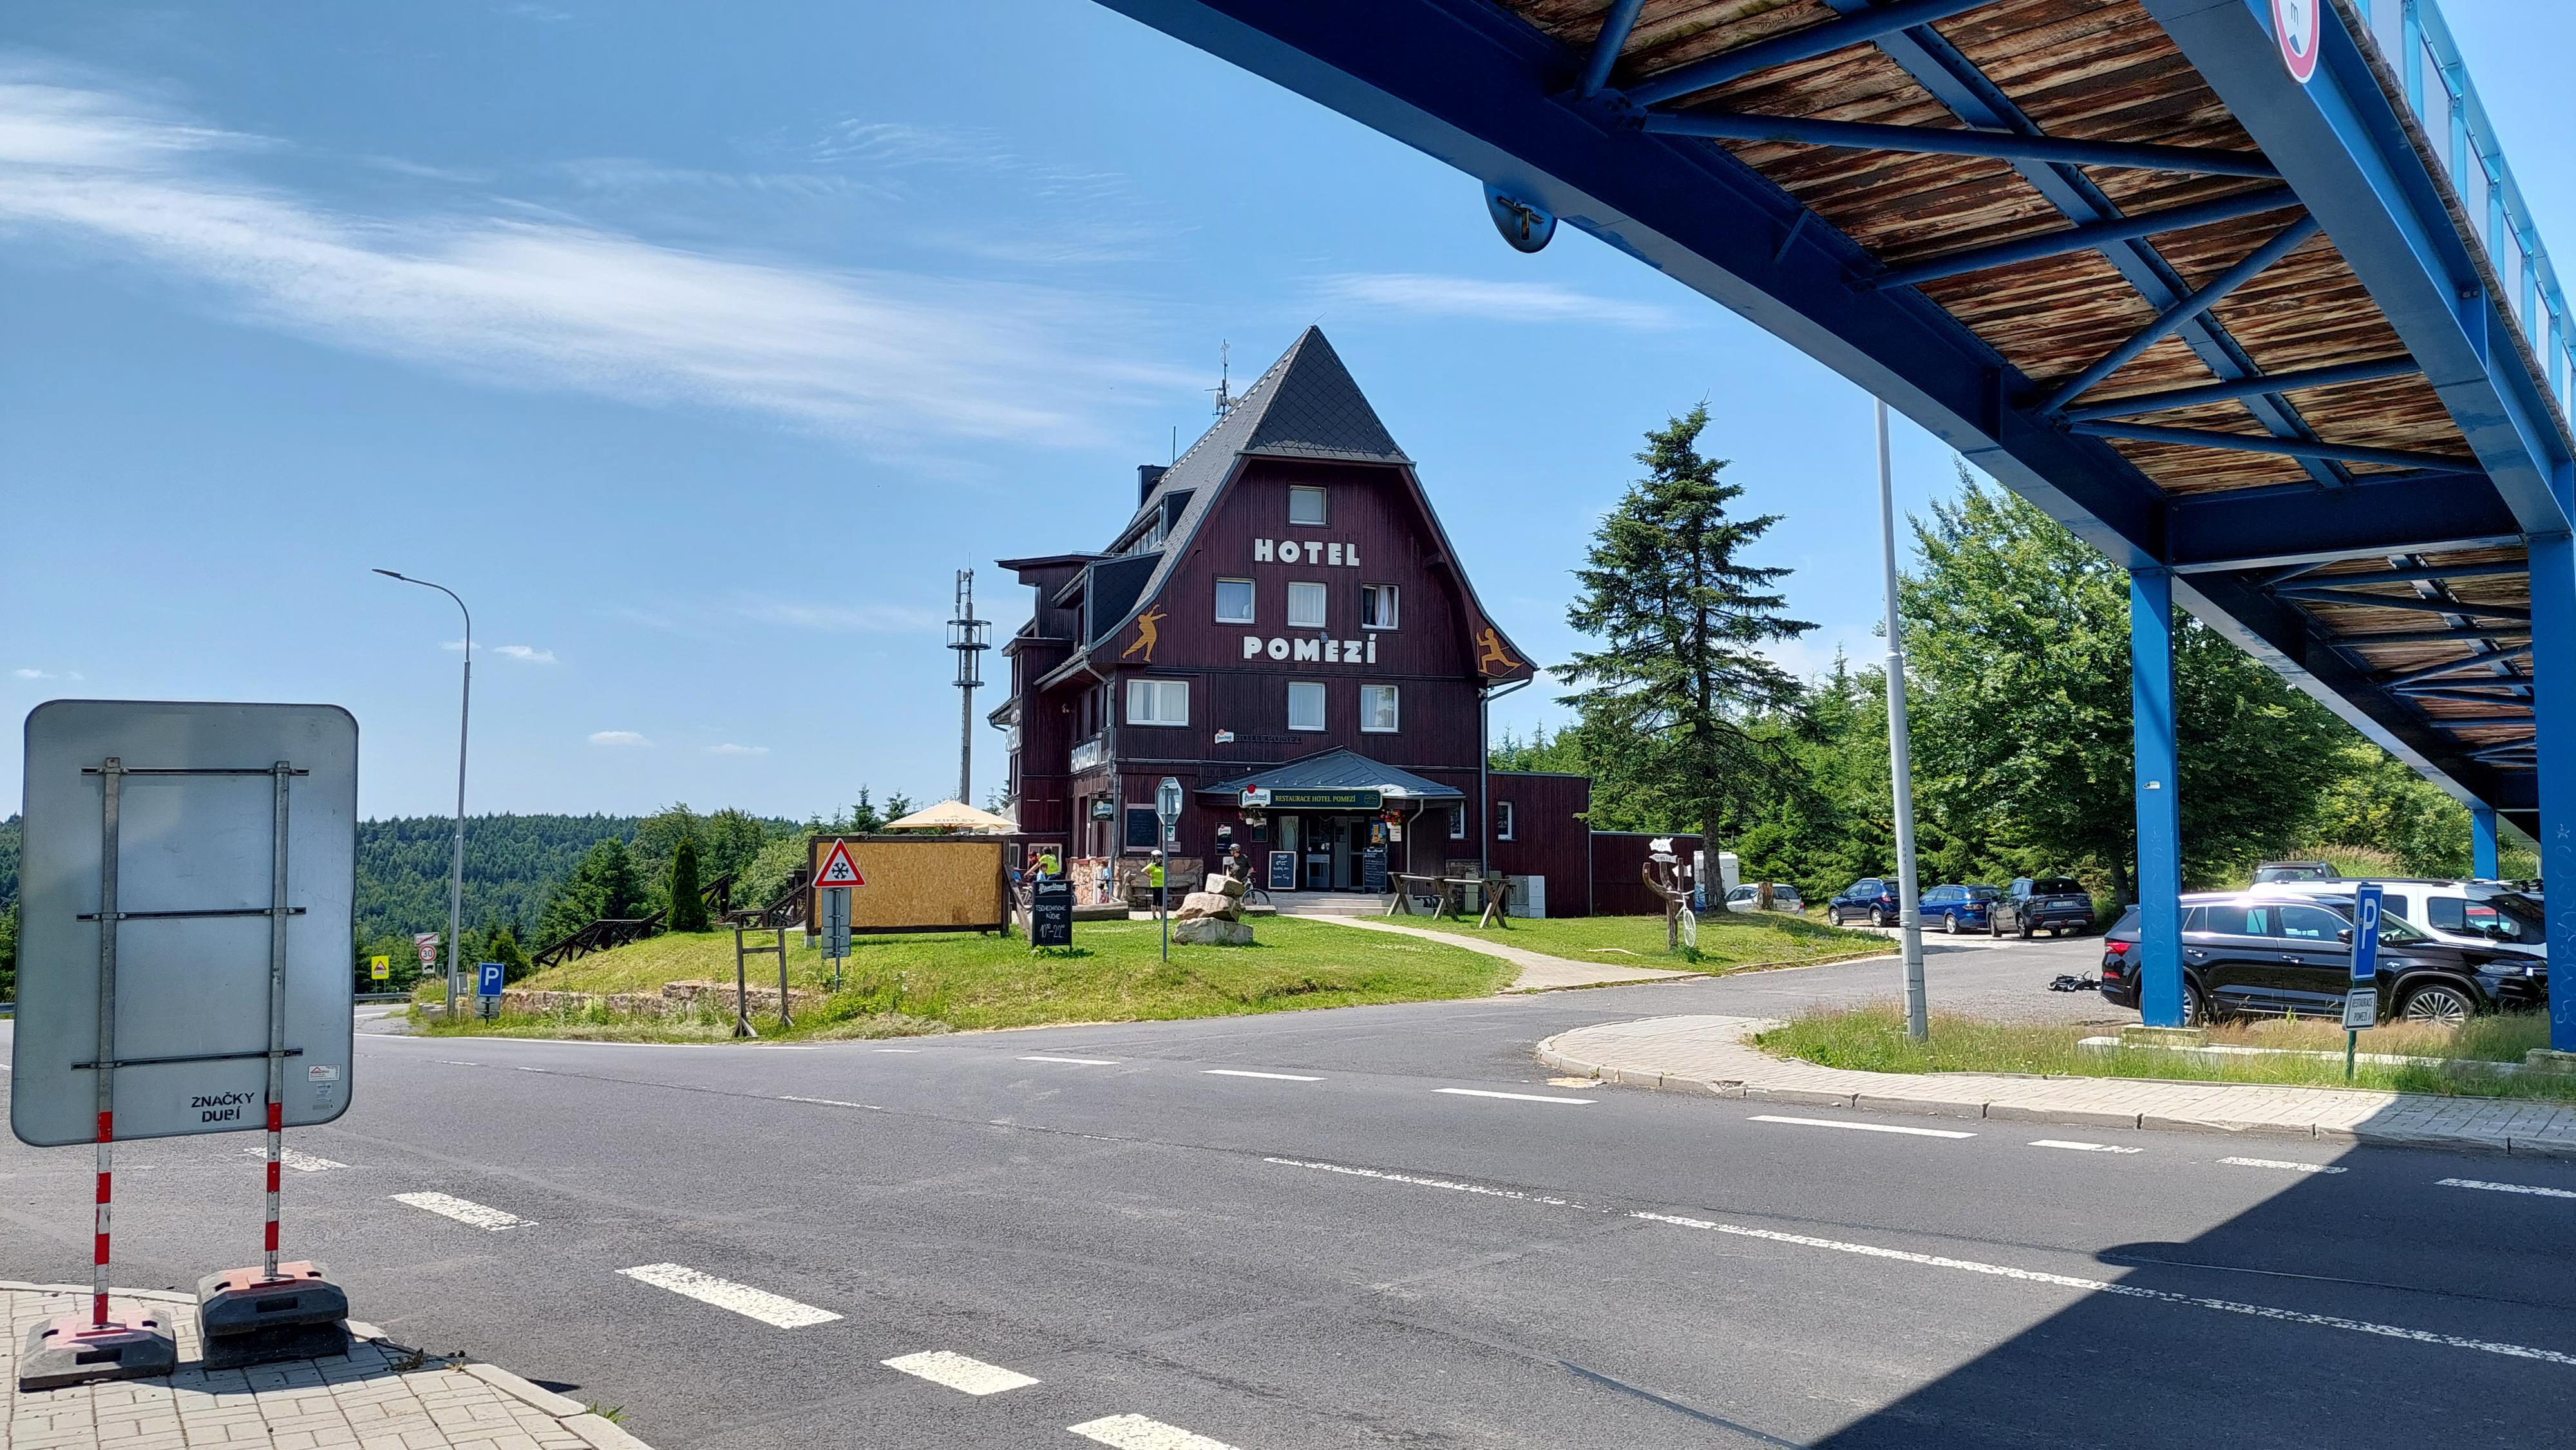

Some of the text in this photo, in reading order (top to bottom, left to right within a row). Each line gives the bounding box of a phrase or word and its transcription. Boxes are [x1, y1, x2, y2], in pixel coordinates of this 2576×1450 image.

[2290, 1, 2299, 26] m
[1255, 538, 1360, 567] HOTEL
[1243, 633, 1377, 664] POMEZÍ
[1332, 794, 1356, 803] POMEZÍ
[1045, 911, 1061, 920] KÜCHE
[2361, 898, 2378, 950] P
[422, 949, 433, 958] 30
[484, 967, 500, 986] P
[2352, 997, 2373, 1008] RESTAURACE
[191, 1091, 256, 1108] ZNAČKY
[201, 1106, 242, 1123] DUBÍ
